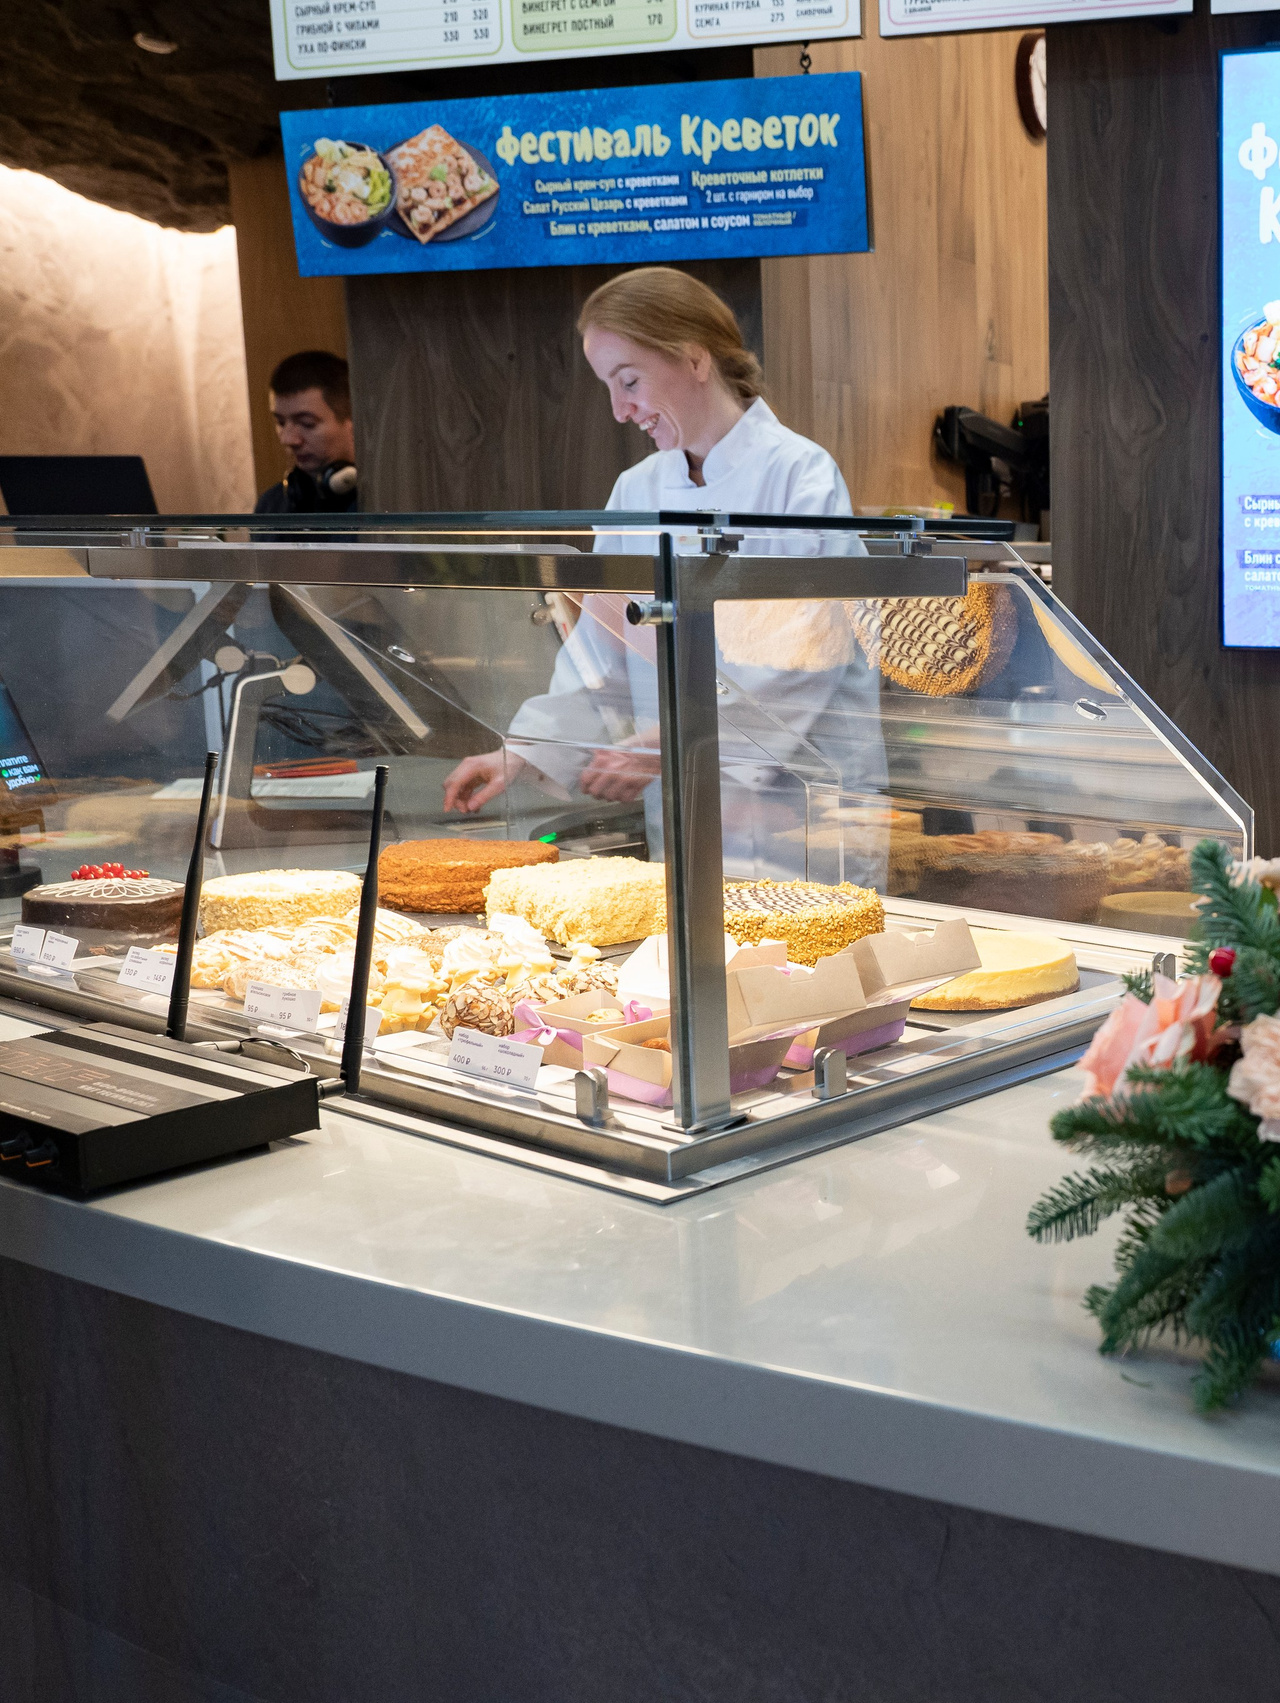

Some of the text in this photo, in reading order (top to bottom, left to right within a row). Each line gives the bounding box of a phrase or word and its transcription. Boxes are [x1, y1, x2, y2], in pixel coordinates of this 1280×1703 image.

[294, 1, 331, 18] СЫРНЫЙ
[522, 0, 567, 14] ВИНЕГРЕТ
[694, 1, 730, 14] КУРИНАЯ
[731, 0, 761, 11] ГРУДКА
[295, 18, 380, 36] ГРИБНОЙ С ЧИПАМИ
[522, 13, 663, 36] ВИНЕГРЕТ ПОСТНЫЙ 170
[680, 112, 841, 166] Креветок
[534, 174, 680, 196] Сырный крем-суп с креветками
[691, 166, 824, 191] Креветочные котлетки
[706, 190, 712, 204] 2
[728, 192, 735, 202] с
[735, 188, 775, 204] гарниром
[775, 189, 786, 200] на
[787, 185, 814, 201] выбор
[522, 195, 689, 216] Салат Русский Цезарь с креветками
[549, 220, 577, 237] Блин
[578, 223, 586, 235] с
[653, 217, 700, 232] салатом
[701, 215, 710, 230] и
[710, 214, 751, 232] соусом
[1243, 517, 1252, 528] с
[1243, 550, 1273, 565] Блин
[8, 763, 39, 777] как вам
[5, 774, 35, 790] удобно
[453, 1053, 465, 1064] 400
[493, 1065, 506, 1076] 300
